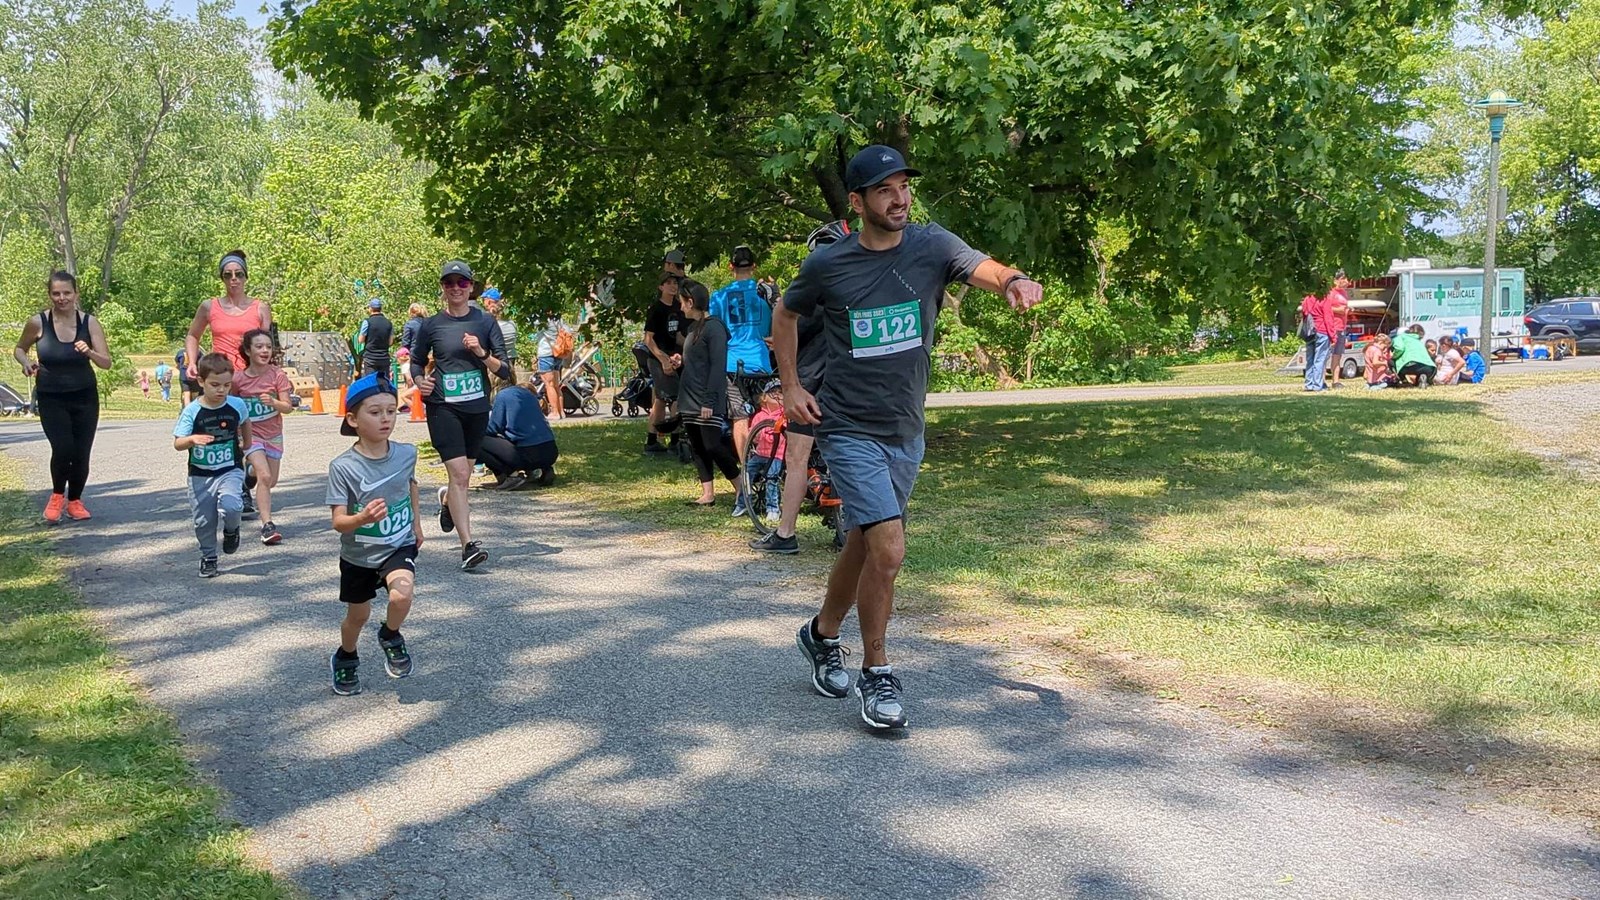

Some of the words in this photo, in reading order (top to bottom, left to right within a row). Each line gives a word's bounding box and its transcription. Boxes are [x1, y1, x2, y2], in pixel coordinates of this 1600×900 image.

[878, 314, 917, 343] 122
[460, 377, 482, 395] 123
[207, 448, 232, 465] 036
[379, 507, 410, 535] 029
